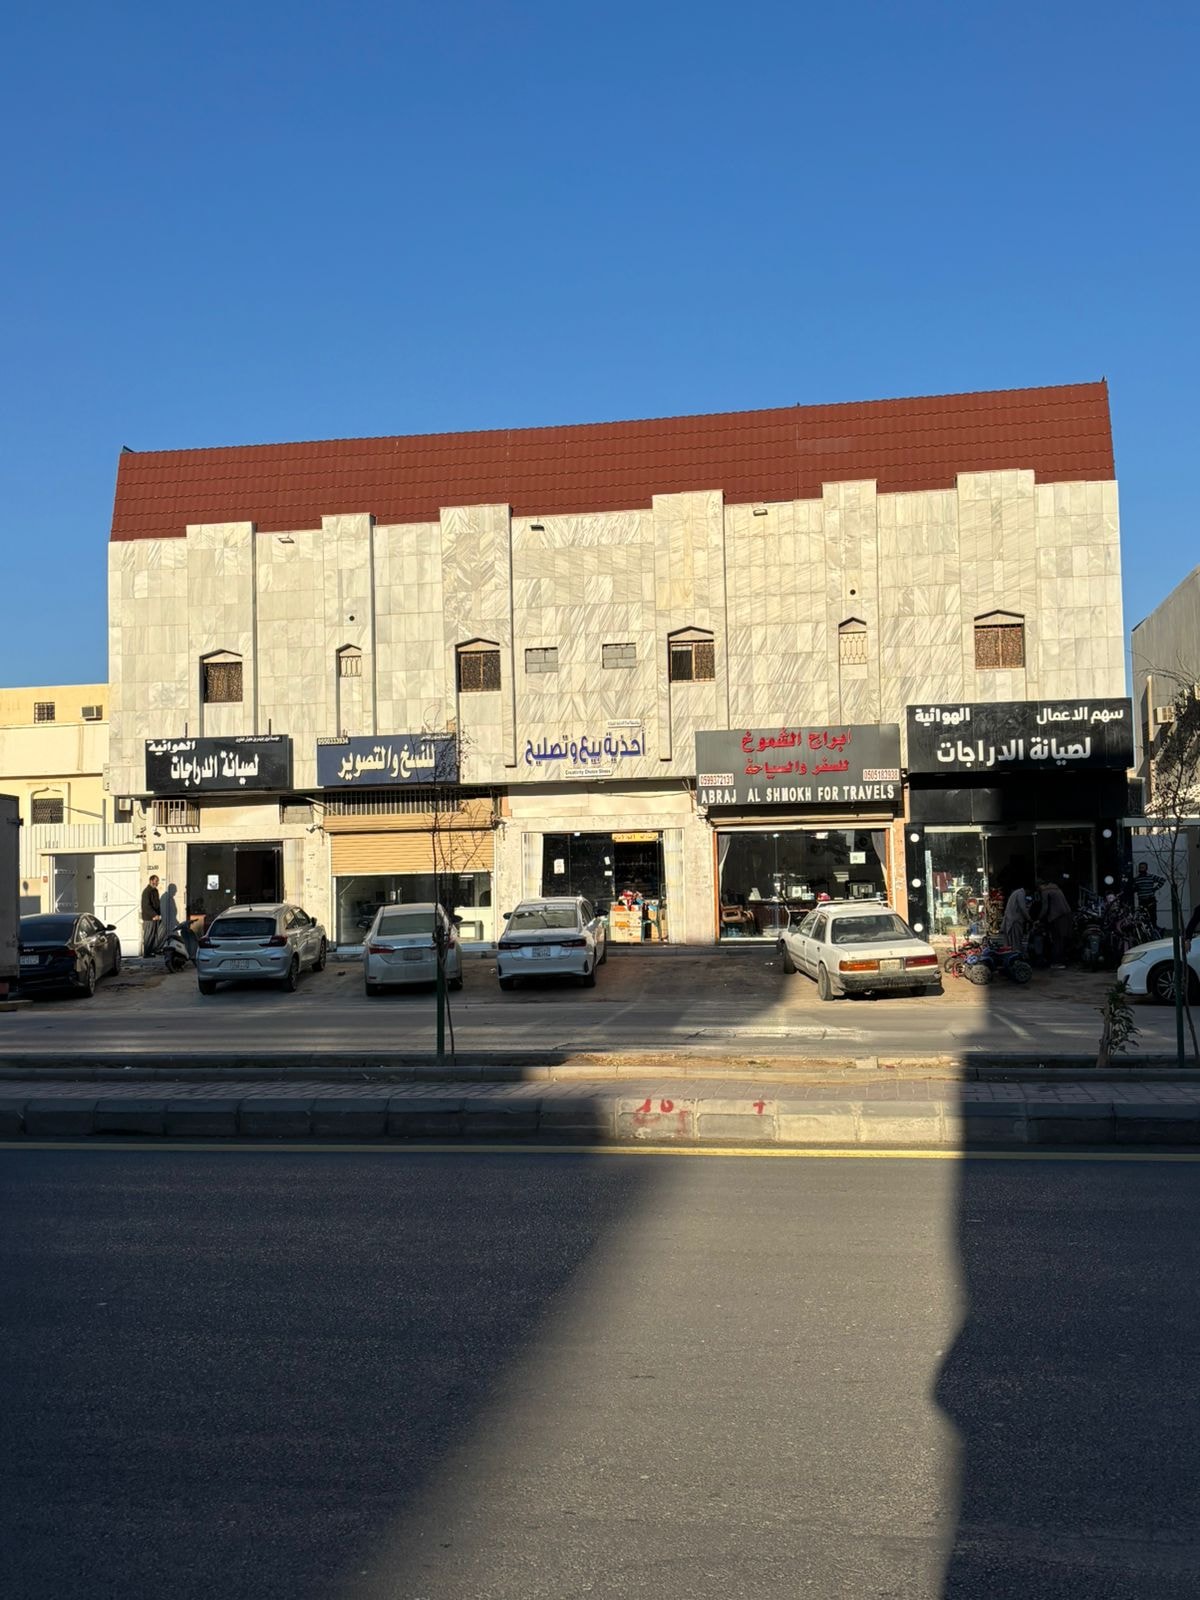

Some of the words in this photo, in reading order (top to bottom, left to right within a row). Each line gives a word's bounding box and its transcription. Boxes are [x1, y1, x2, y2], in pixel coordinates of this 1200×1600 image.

[915, 707, 971, 727] الهوائية
[1036, 706, 1089, 725] الاعمال
[1090, 707, 1124, 724] سهم
[579, 735, 602, 764] بيع
[808, 728, 852, 752] ابراج
[936, 738, 1025, 767] الدراجات
[1029, 736, 1092, 766] لصيانة
[170, 754, 218, 787] الدراجات
[220, 750, 259, 785] لصيانة
[337, 744, 400, 781] والتصوير
[400, 743, 436, 779] للنسخ
[744, 758, 808, 780] والسياحة
[811, 757, 849, 776] للسفر
[700, 788, 737, 804] ABRAJ
[747, 788, 761, 802] AL
[818, 786, 839, 801] FOR
[842, 784, 896, 801] TRAVELS
